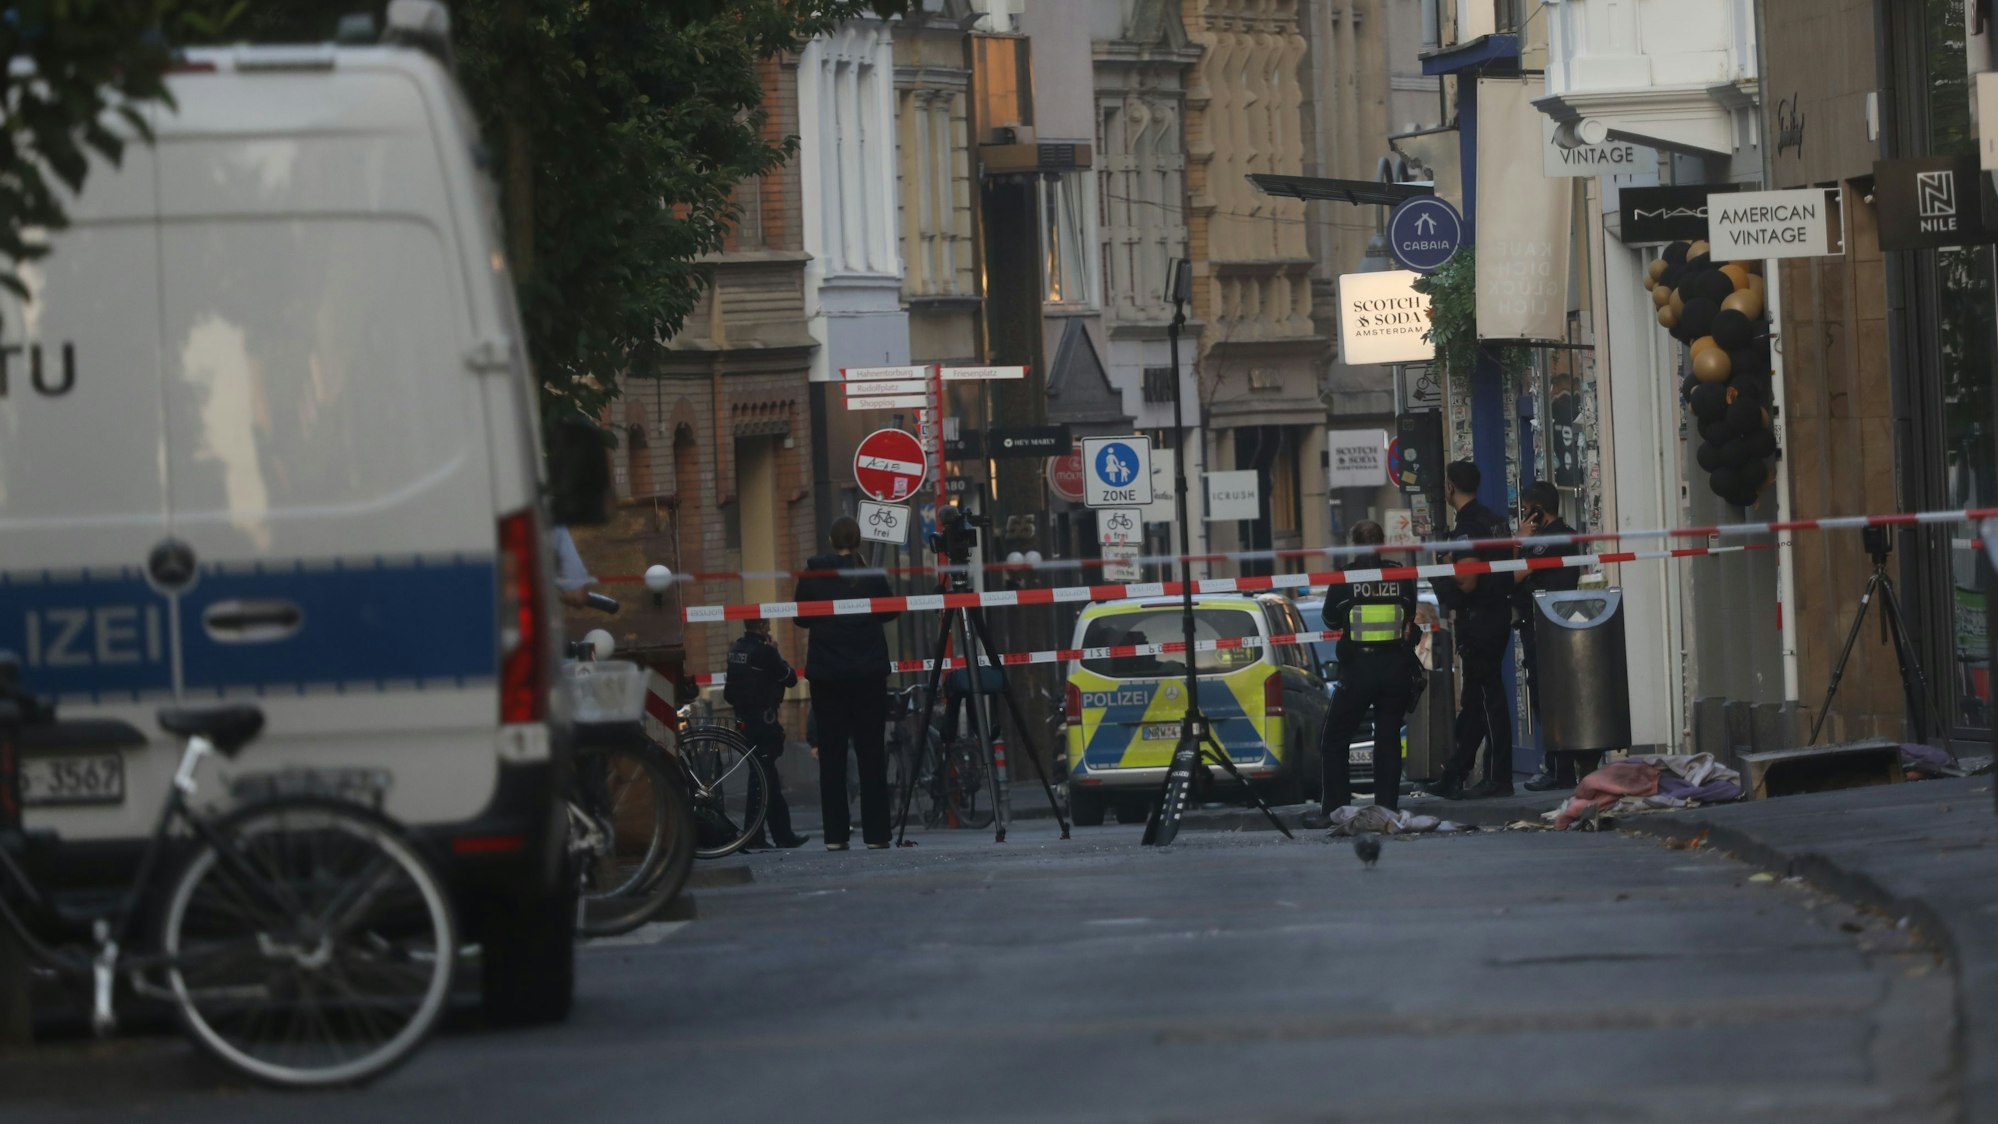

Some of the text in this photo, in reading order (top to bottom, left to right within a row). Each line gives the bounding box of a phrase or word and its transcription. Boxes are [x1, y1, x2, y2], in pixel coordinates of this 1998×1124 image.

[1559, 147, 1634, 165] VINTAGE
[1719, 204, 1815, 225] AMERICAN
[1920, 218, 1957, 233] NILE
[1729, 227, 1806, 245] VINTAGE
[1403, 240, 1449, 251] CABAIA
[1353, 297, 1420, 313] SCOTCH
[1355, 312, 1421, 328] & SODA
[1355, 327, 1423, 337] AMSTERDAM
[857, 369, 913, 378] Hahnentorburg
[953, 369, 997, 378] Friesenplatz
[857, 383, 898, 393] Rudolfplatz
[859, 399, 895, 409] Shopping
[1103, 490, 1136, 501] ZONE
[1212, 491, 1255, 501] ICRUSH
[874, 527, 890, 537] frei
[25, 604, 161, 668] IZEI
[1083, 691, 1149, 708] POLIZEI
